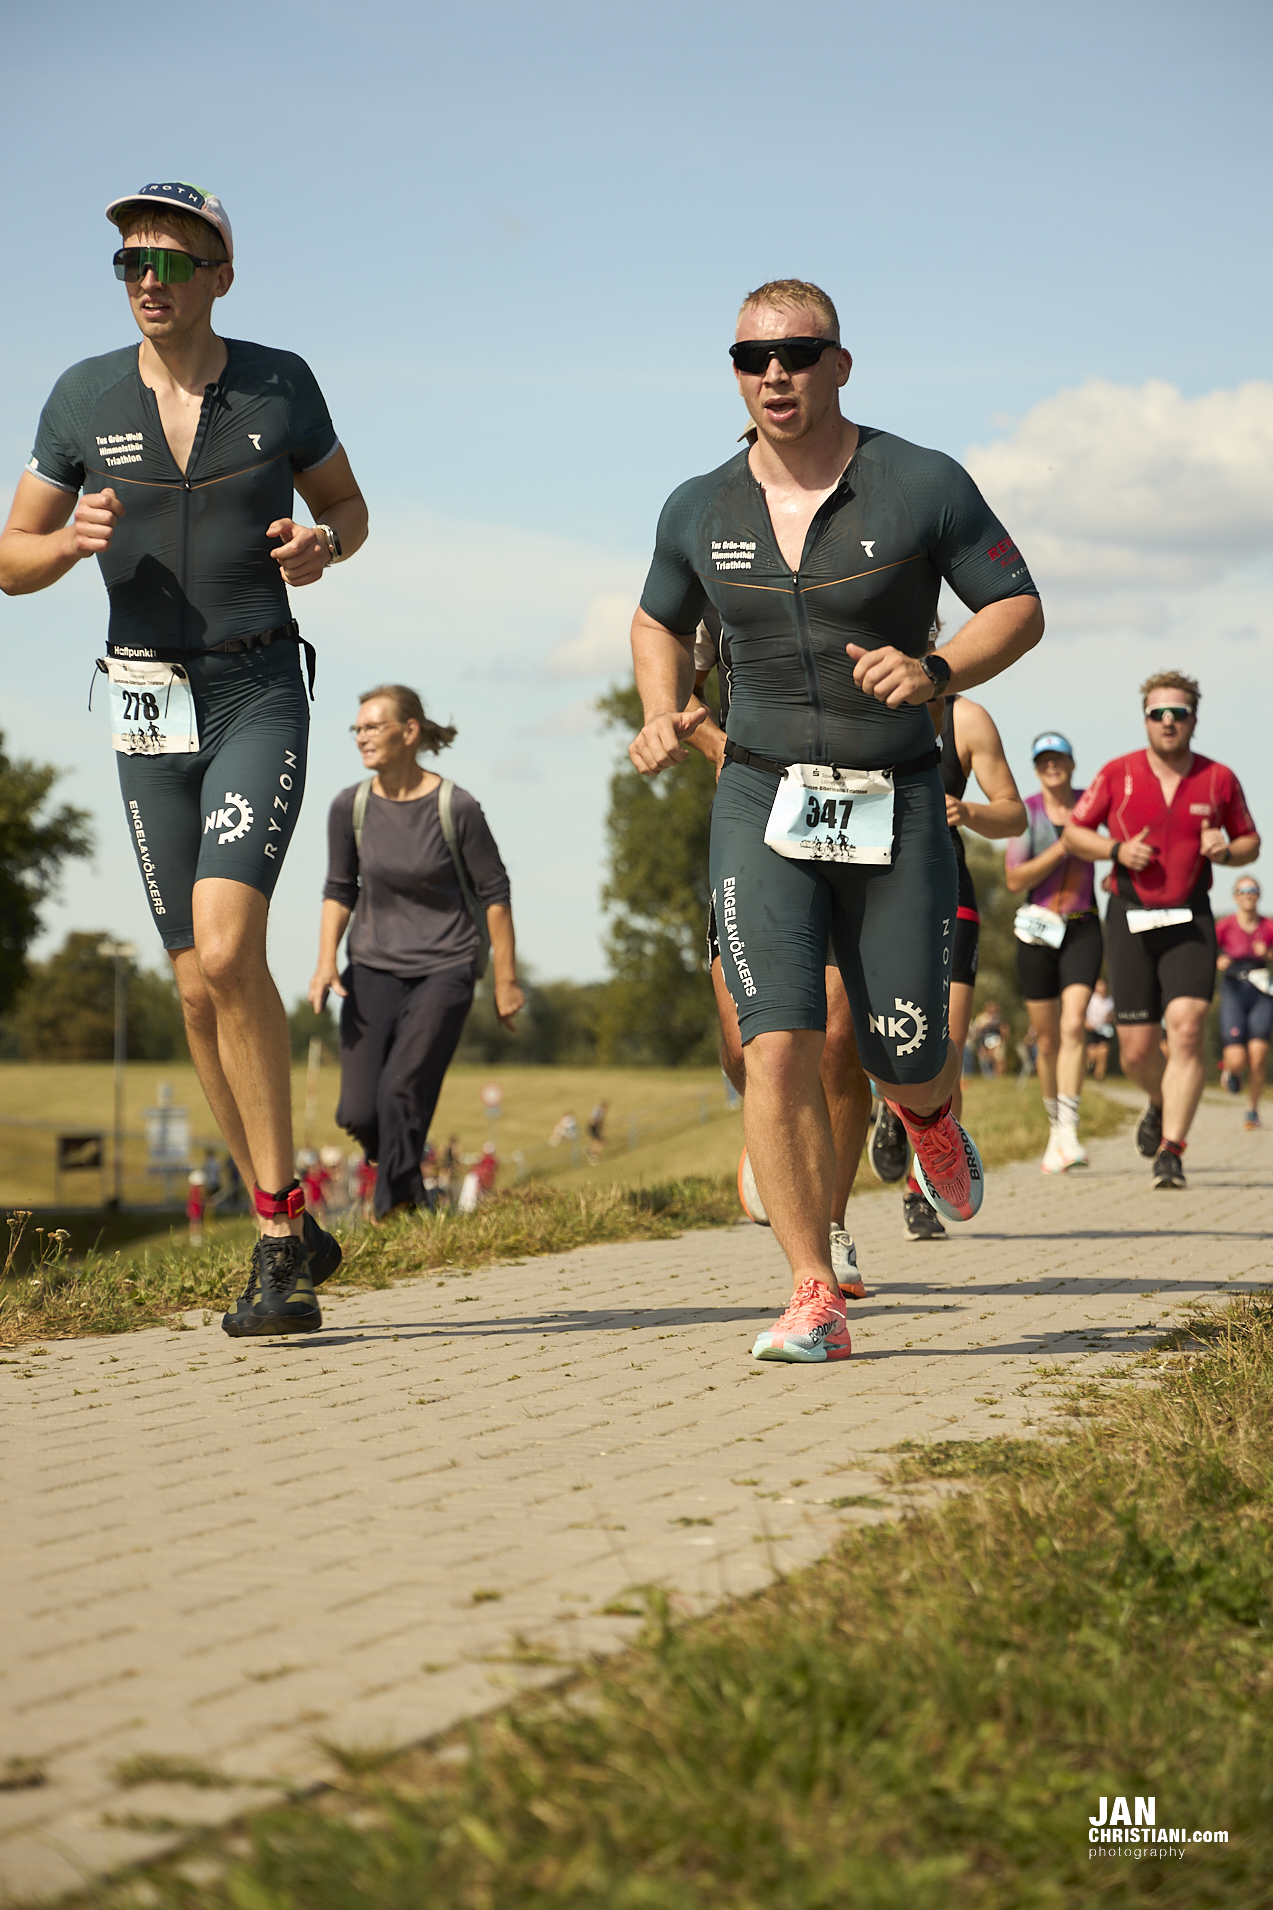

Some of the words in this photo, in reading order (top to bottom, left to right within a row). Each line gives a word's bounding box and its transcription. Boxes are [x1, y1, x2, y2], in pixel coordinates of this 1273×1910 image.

[105, 454, 143, 467] Triathlon
[715, 560, 752, 571] Triathlon
[122, 690, 160, 720] 278
[264, 749, 297, 859] RYZON
[806, 796, 854, 829] 347
